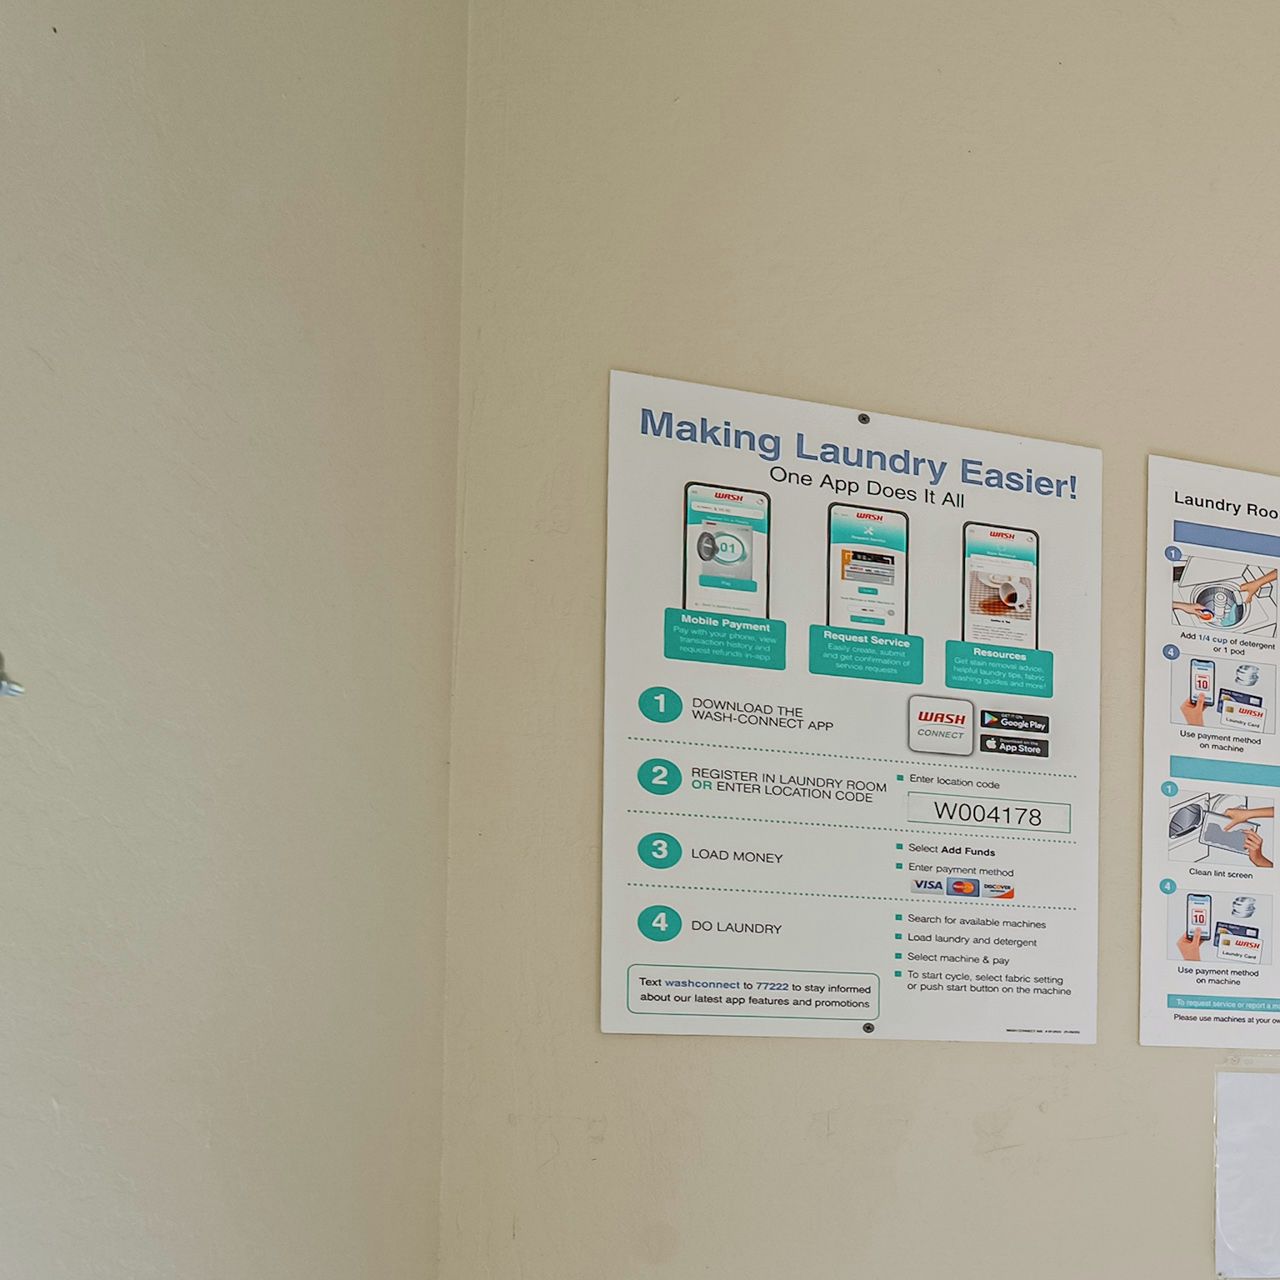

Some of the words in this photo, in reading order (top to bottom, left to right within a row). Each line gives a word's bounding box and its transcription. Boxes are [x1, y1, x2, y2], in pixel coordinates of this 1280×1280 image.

[641, 408, 780, 462] Making
[796, 432, 948, 486] Laundry
[961, 458, 1076, 500] Easier!
[769, 466, 813, 487] One
[819, 473, 860, 496] App
[867, 480, 917, 502] Does
[924, 488, 936, 505] It
[941, 491, 964, 509] All
[1174, 490, 1242, 517] Laundry
[681, 614, 719, 627] Mobile
[722, 617, 770, 633] Payment
[823, 630, 869, 643] Request
[868, 635, 911, 648] Service
[972, 646, 1027, 661] Resources
[653, 693, 665, 713] 1
[692, 697, 774, 715] DOWNLOAD
[777, 705, 803, 718] THE
[691, 709, 805, 729] WASH-CONNECT
[807, 720, 834, 731] APP
[918, 711, 966, 727] WASH
[1000, 718, 1029, 729] Google
[1029, 720, 1046, 731] Play
[917, 728, 965, 739] CONNECT
[999, 742, 1018, 753] App
[1018, 744, 1041, 754] Store
[651, 765, 669, 785] 2
[691, 767, 758, 782] REGISTER
[762, 773, 776, 784] IN
[779, 774, 843, 789] LAUNDRY
[846, 779, 887, 792] ROOM
[691, 779, 712, 790] OR
[716, 781, 761, 794] ENTER
[764, 785, 832, 800] LOCATION
[835, 790, 873, 803] CODE
[933, 801, 1042, 827] W004178
[651, 839, 669, 860] 3
[691, 848, 730, 861] LOAD
[733, 851, 784, 864] MONEY
[1188, 867, 1213, 876] Clean
[1213, 870, 1226, 878] lint
[651, 912, 669, 932] 4
[691, 920, 713, 932] DO
[716, 922, 782, 934] LAUNDRY
[638, 976, 662, 987] Text
[664, 979, 740, 989] washconnect
[743, 981, 754, 990] to
[756, 982, 789, 991] 77222
[791, 983, 802, 992] to
[804, 984, 826, 994] stay
[827, 984, 872, 994] informed
